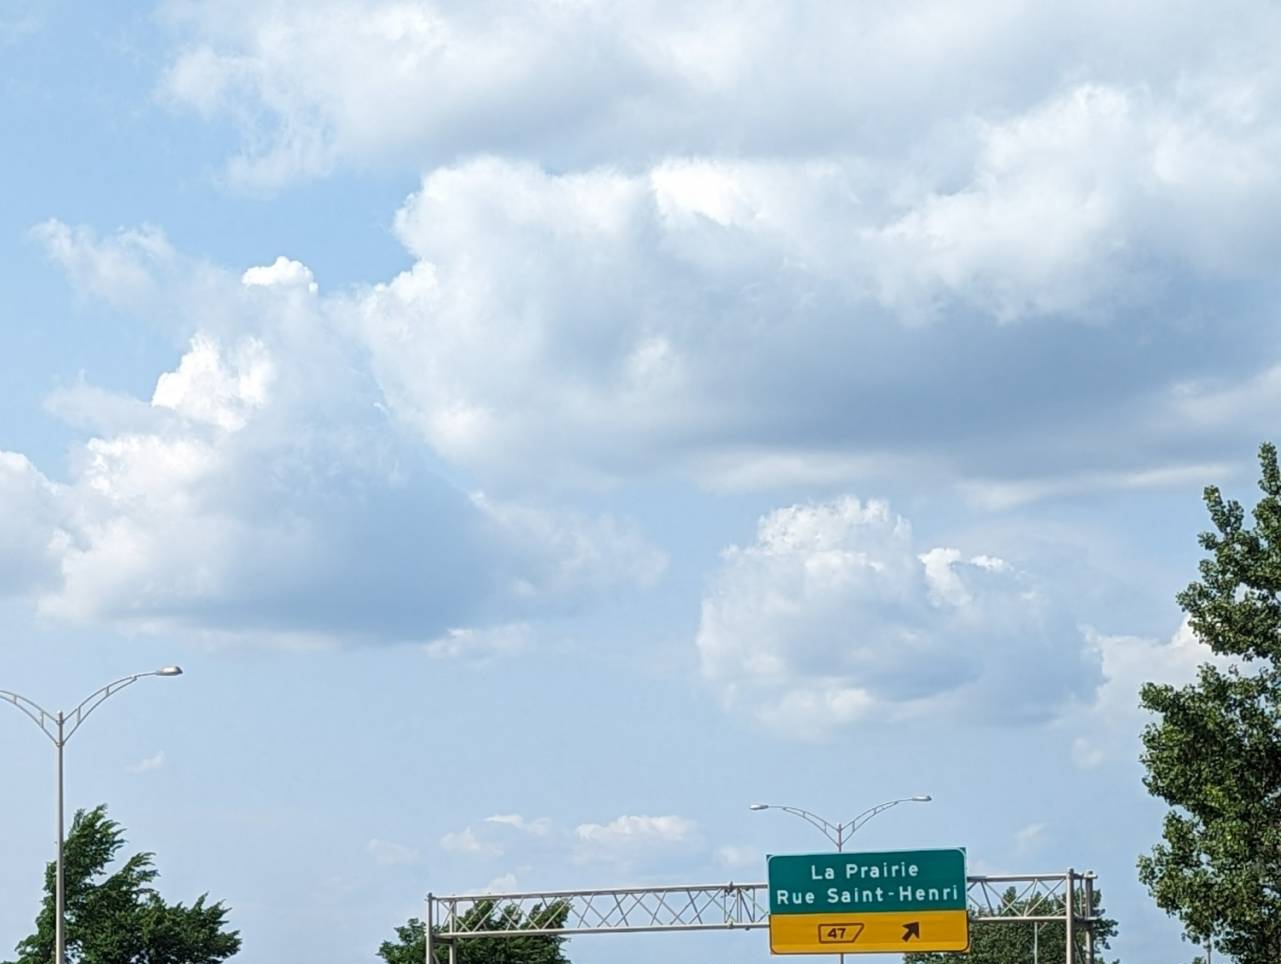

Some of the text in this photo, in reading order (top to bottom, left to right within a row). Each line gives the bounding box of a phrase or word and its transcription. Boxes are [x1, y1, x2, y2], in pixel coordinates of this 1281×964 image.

[811, 861, 919, 880] La Prairie
[776, 884, 958, 905] Rue Saint-Henri
[827, 927, 846, 939] 47
